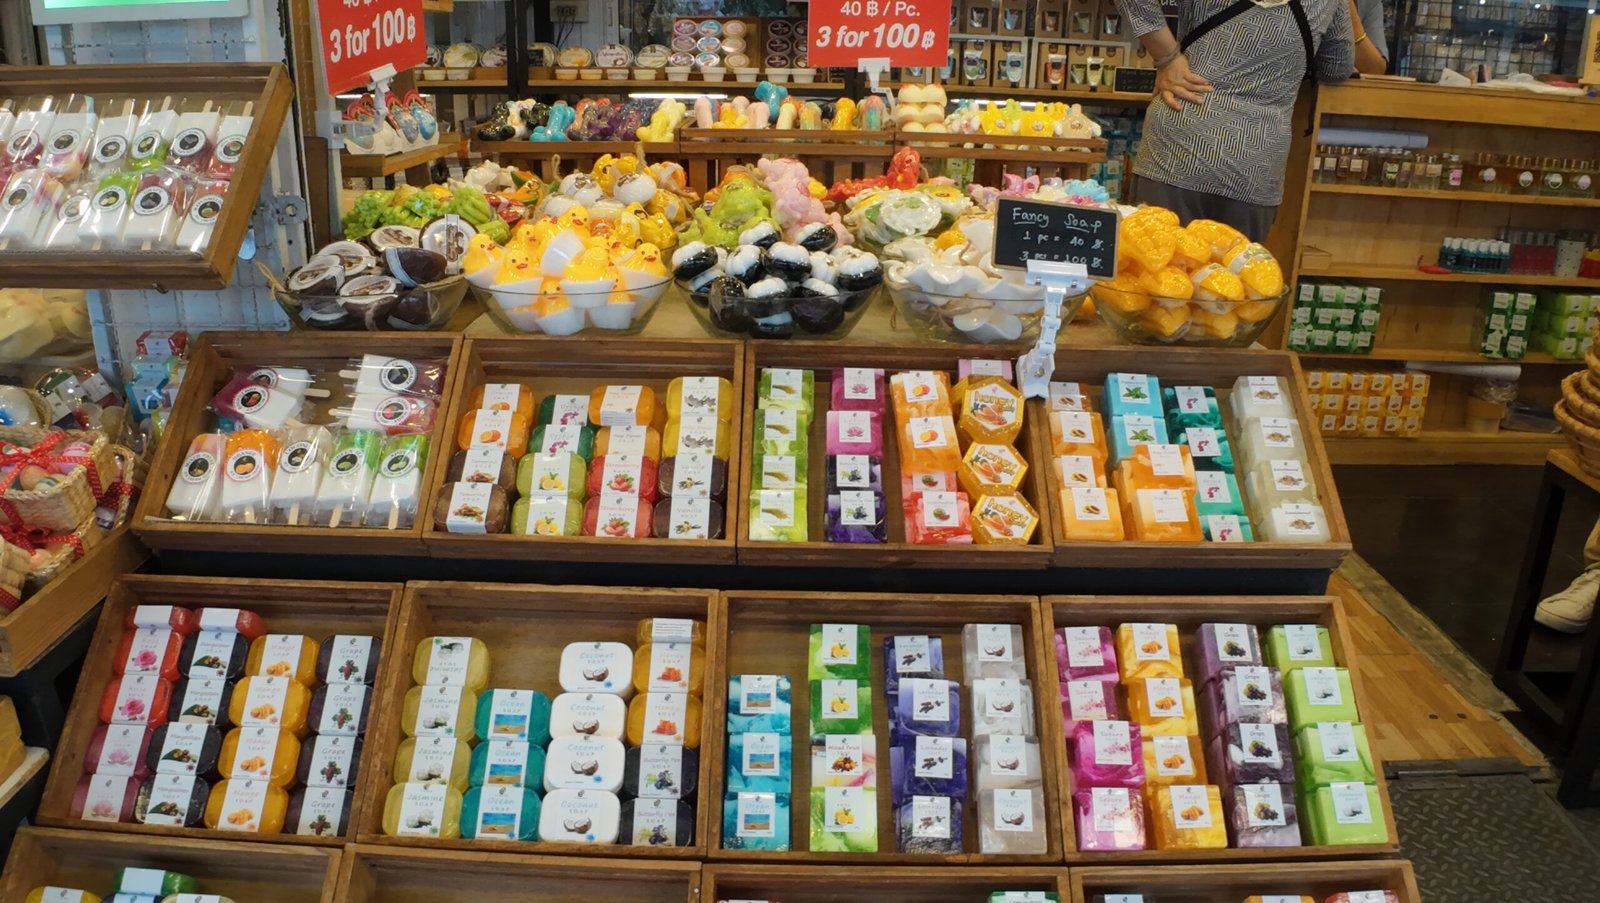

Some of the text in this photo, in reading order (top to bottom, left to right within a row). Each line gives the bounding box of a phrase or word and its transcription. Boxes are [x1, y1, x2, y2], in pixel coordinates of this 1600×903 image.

[840, 1, 862, 17] 40
[895, 1, 921, 17] Pc.
[329, 28, 342, 63] 3
[345, 23, 371, 59] for
[372, 7, 405, 51] 100
[815, 25, 832, 48] 3
[835, 25, 870, 48] for
[873, 22, 921, 49] 100
[1012, 207, 1102, 234] Fancy Soap
[1070, 236, 1085, 247] 40
